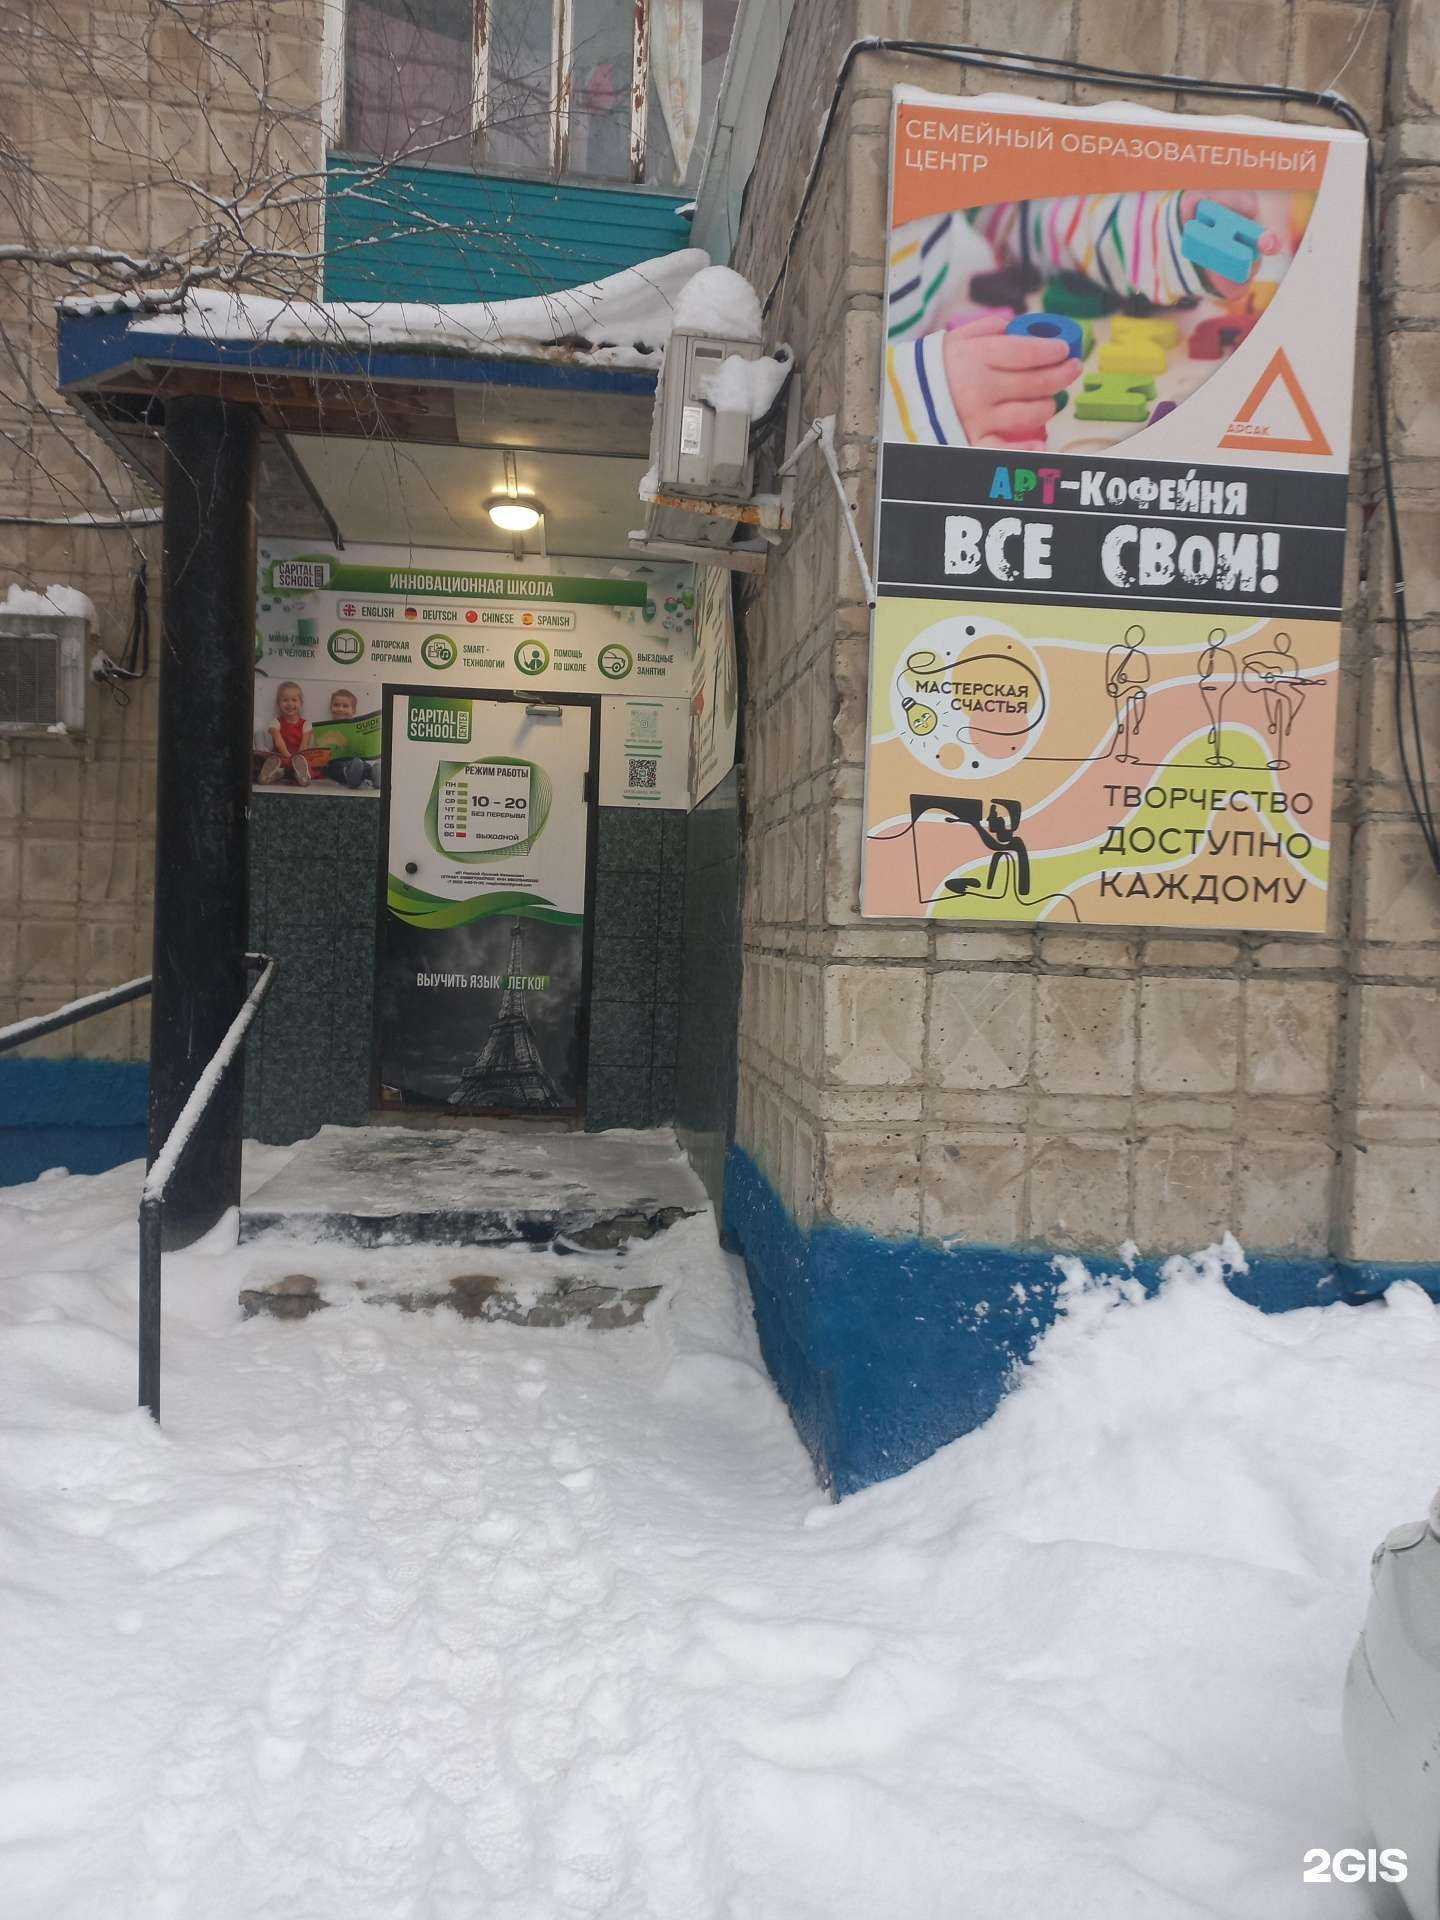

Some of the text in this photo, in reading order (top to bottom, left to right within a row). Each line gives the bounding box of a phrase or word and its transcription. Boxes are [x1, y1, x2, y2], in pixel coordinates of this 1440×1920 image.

[905, 119, 1317, 173] СЕМЕЙНЫЙ ОБРАЗОВАТЕЛЬНЫЙ
[905, 149, 988, 174] ЦЕНТР
[944, 515, 1281, 594] ВСЕ СВОИ!
[280, 564, 314, 576] CAPITAL
[280, 575, 314, 587] SCHOOL
[390, 573, 554, 597] ИННОВАЦИОННАЯ ШКОЛА
[361, 606, 394, 618] ENGLISH
[422, 609, 457, 621] DEUTSCH
[481, 612, 514, 624] CHINESE
[537, 615, 570, 627] SPANISH
[371, 640, 410, 651] АВТОРСКАЯ
[371, 654, 412, 664] ПРОГРАММА
[553, 648, 583, 660] ПОМОЩЬ
[637, 653, 674, 664] ВЫЕЗДНЫЕ
[463, 657, 505, 669] ТЕХНОЛОГИИ
[553, 662, 587, 673] ПО ШКОЛЕ
[637, 665, 666, 677] ЗАНЯТИЯ
[915, 679, 1029, 699] МАСТЕРСКАЯ
[950, 697, 1029, 715] СЧАСТЬЯ
[410, 708, 456, 724] CAPITAL
[410, 722, 456, 739] SCHOOL
[465, 766, 529, 778] РЕЖИМ РАБОТЫ
[472, 795, 490, 807] 10
[504, 797, 527, 810] 20
[1103, 785, 1313, 816] ТВОРЧЕСТВО
[486, 811, 526, 819] ПЕРЕРЫВА
[1100, 826, 1313, 860] ДОСТУПНО
[1100, 871, 1307, 905] КАЖДОМУ
[416, 972, 545, 991] ВЫУЧИТЬ ЯЗЫК ЛЕГКО!
